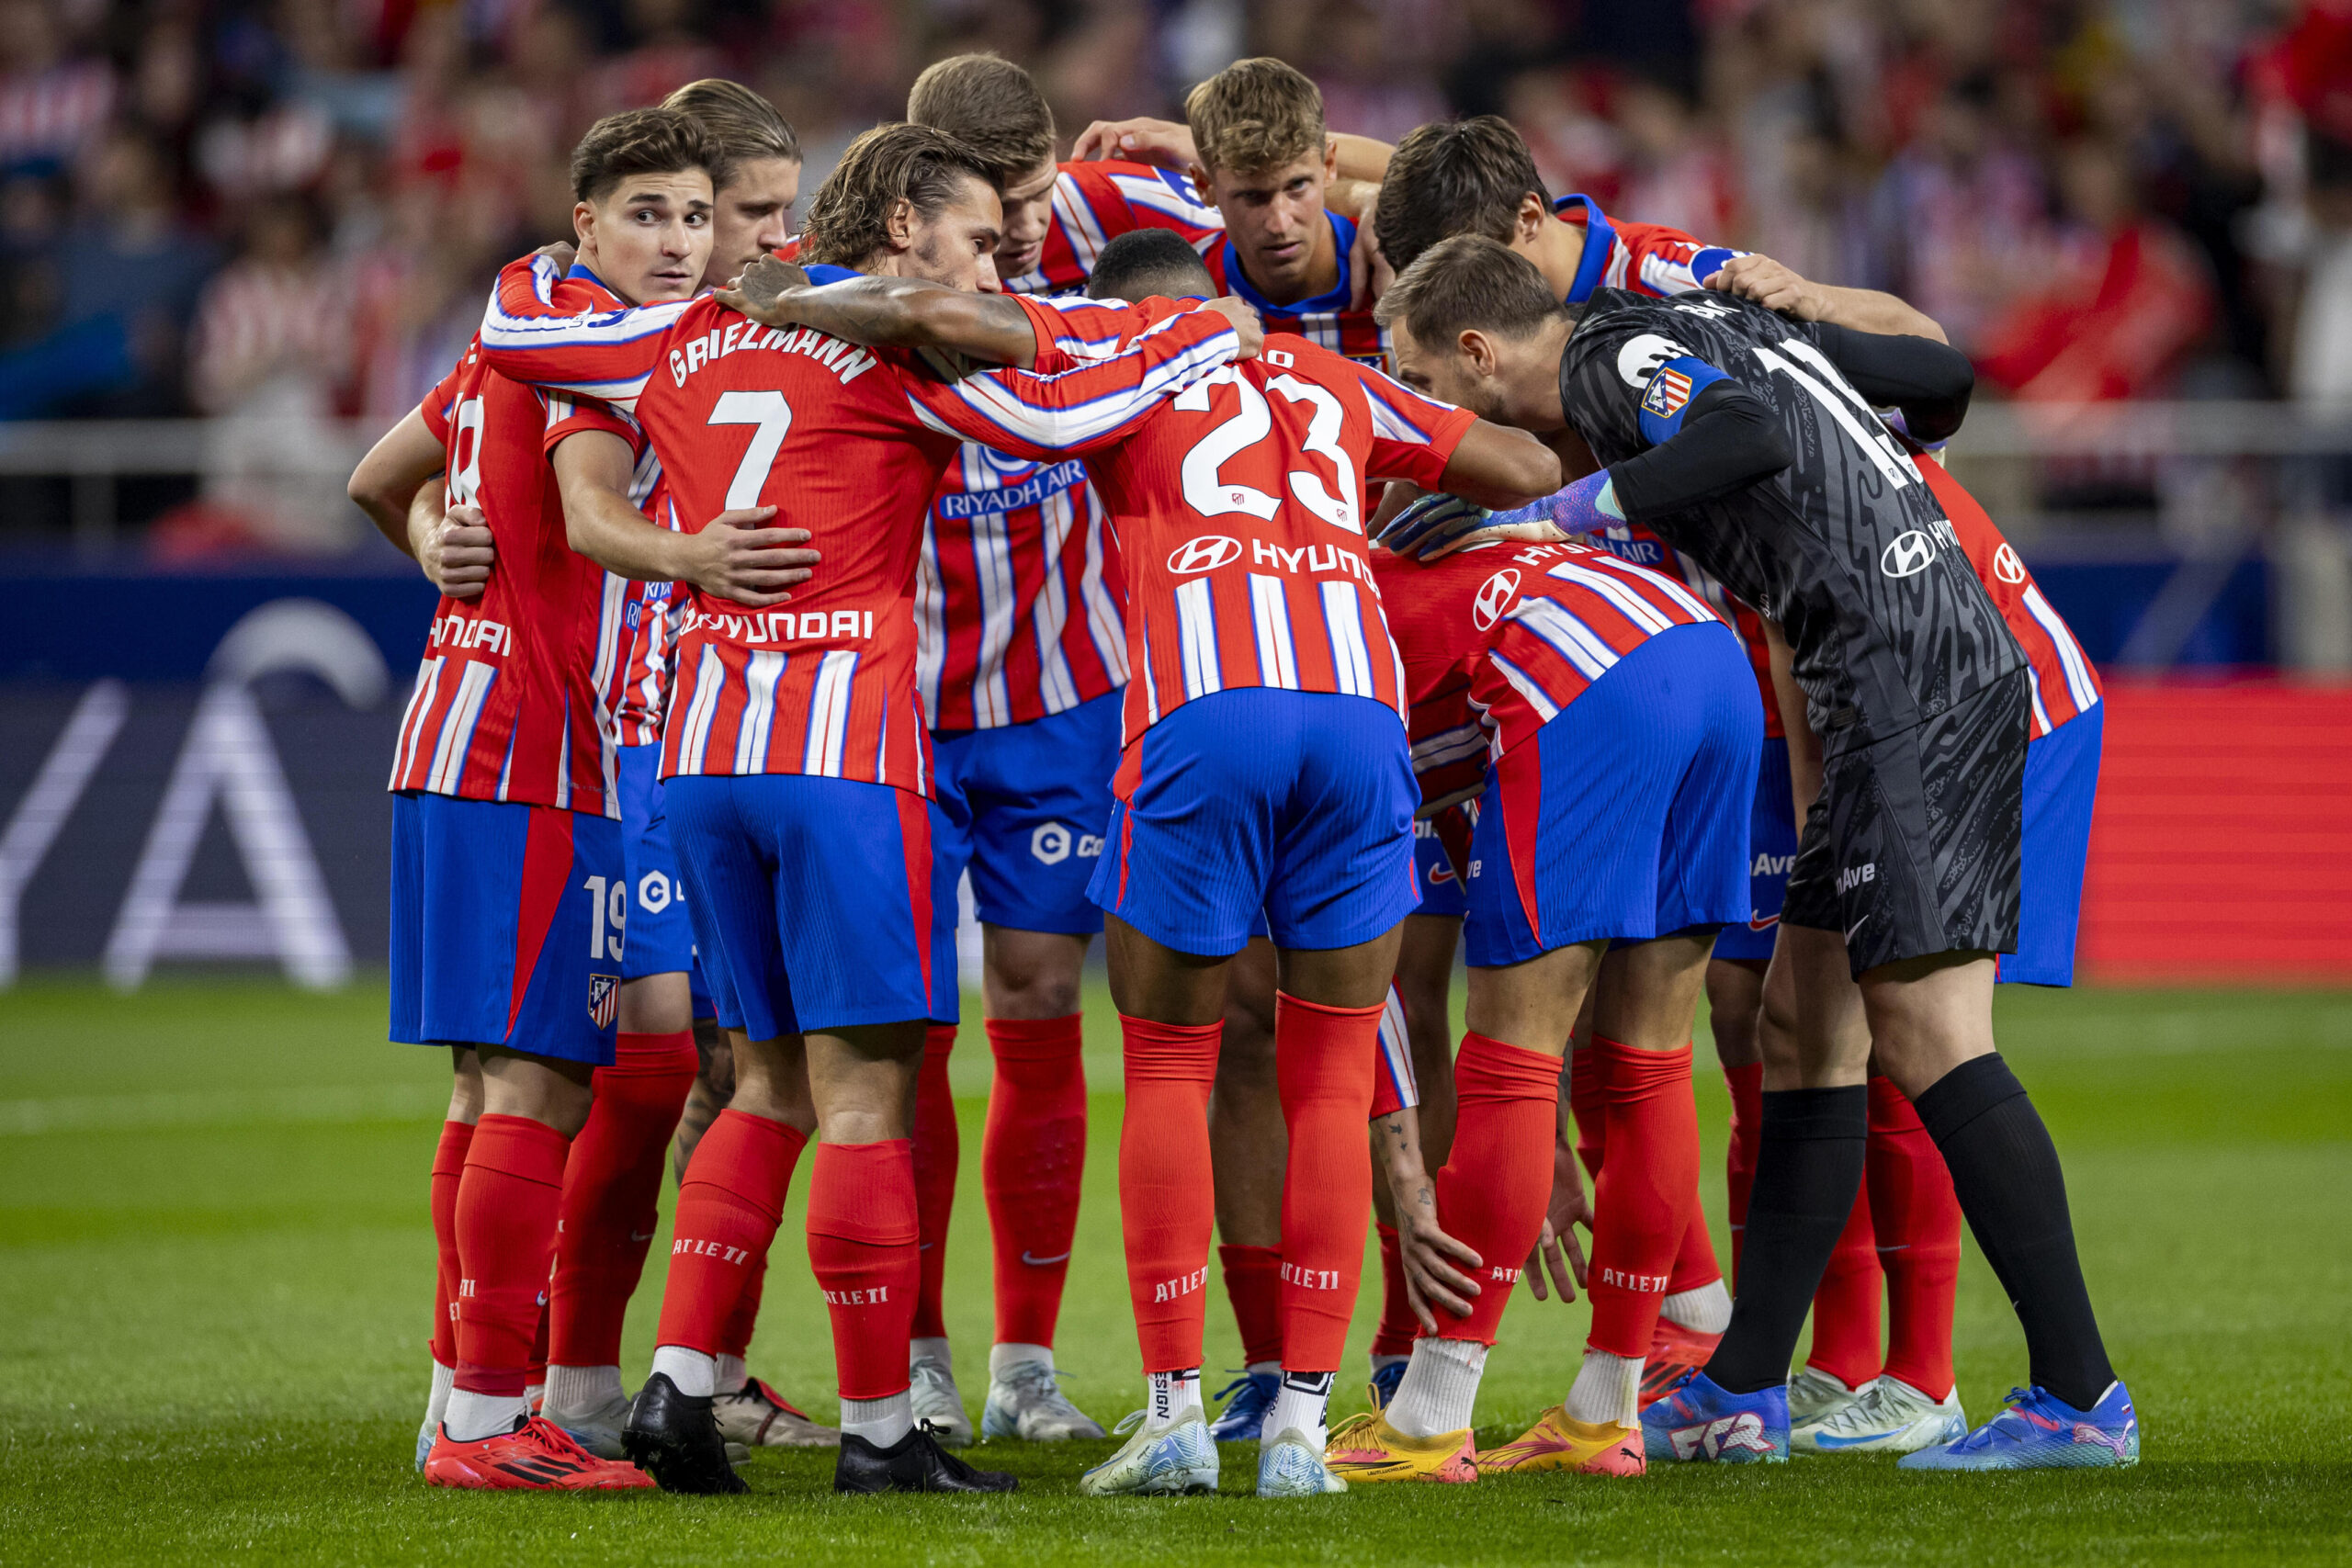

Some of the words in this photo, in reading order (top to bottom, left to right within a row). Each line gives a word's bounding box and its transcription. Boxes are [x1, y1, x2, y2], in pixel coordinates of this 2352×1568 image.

[669, 318, 878, 389] GRIEZMANN
[707, 389, 793, 530] 7
[1172, 364, 1364, 536] 23
[945, 478, 1043, 517] RIYADH
[1046, 458, 1085, 494] AIR
[1622, 542, 1660, 563] AIR
[583, 874, 627, 963] 19
[673, 1238, 750, 1266] ATLETI
[1281, 1261, 1339, 1290] ATLETI
[1602, 1268, 1668, 1293] ATLETI
